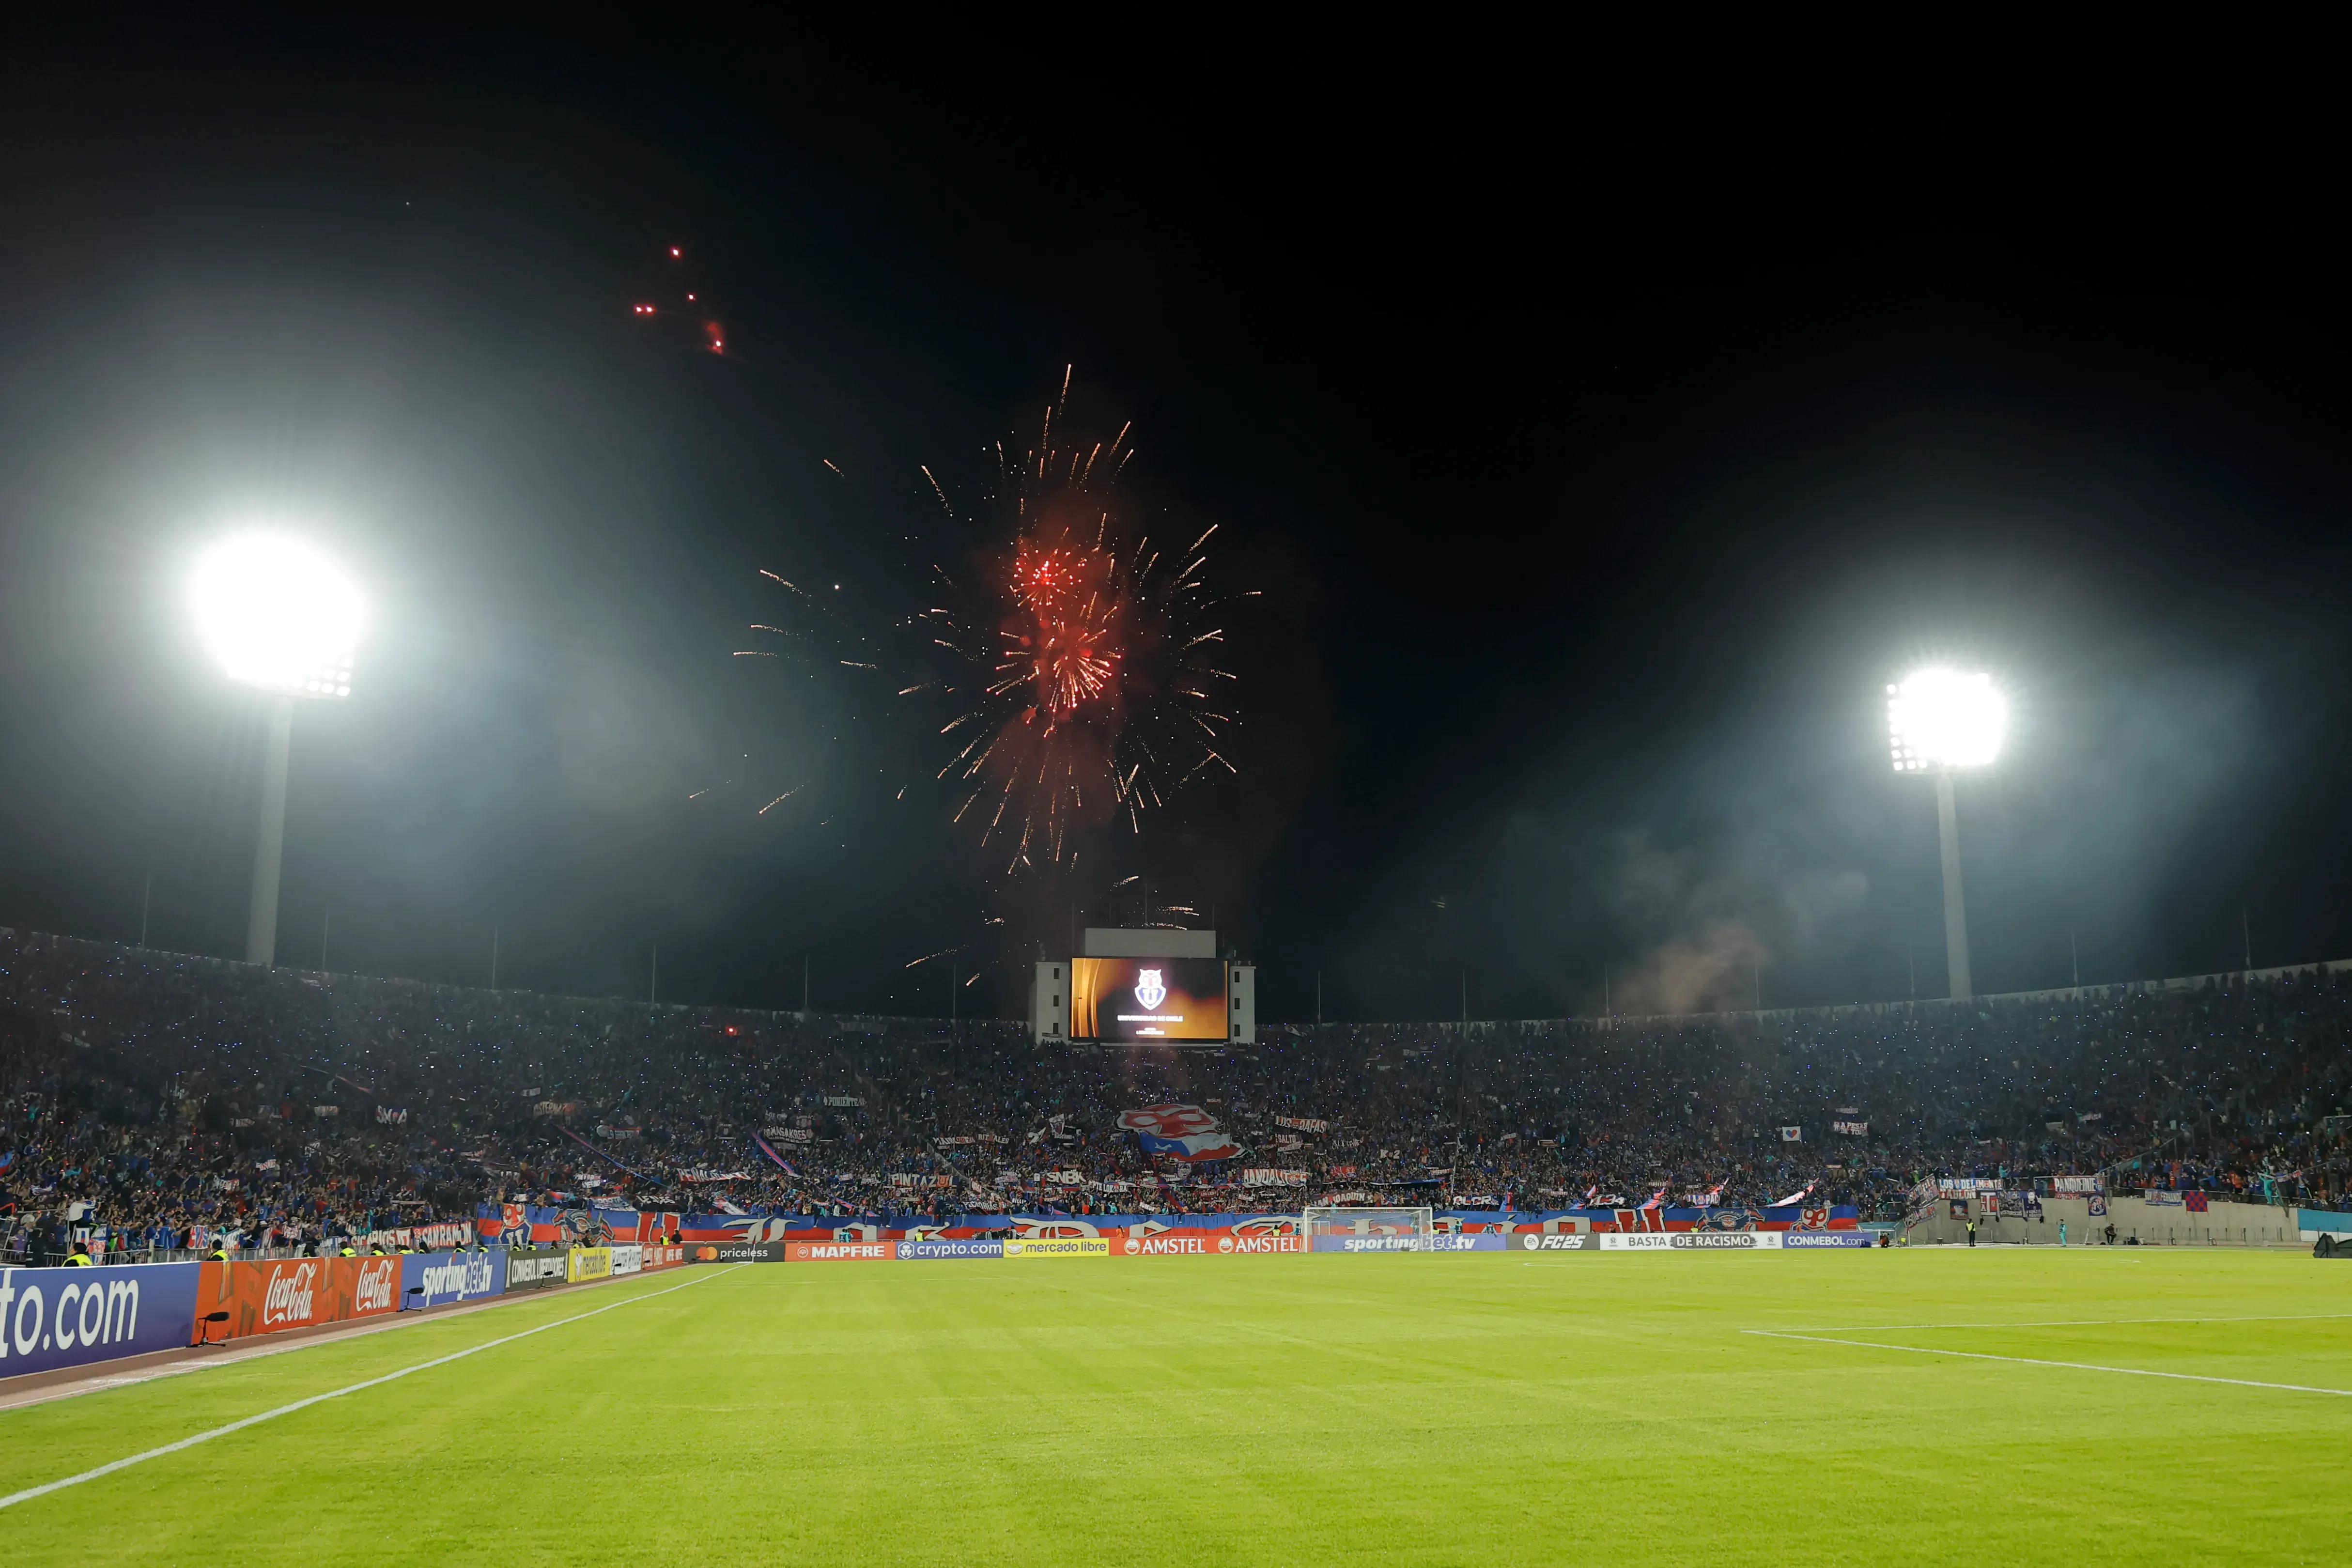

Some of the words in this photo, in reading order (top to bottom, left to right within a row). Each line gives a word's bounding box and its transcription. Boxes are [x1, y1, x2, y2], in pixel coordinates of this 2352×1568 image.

[1278, 1134, 1296, 1144] SALTO
[1939, 1179, 1953, 1189] LOS
[1961, 1179, 1976, 1189] DEL
[1025, 1242, 1079, 1253] mercado
[1081, 1241, 1107, 1252] libre
[1141, 1238, 1206, 1254] AMSTEL
[1235, 1237, 1298, 1253] AMSTEL
[1344, 1233, 1476, 1252] sportingbet.tv
[1540, 1235, 1587, 1249] FC25
[1628, 1237, 1667, 1246] BASTA
[1676, 1236, 1693, 1246] DE
[1696, 1235, 1751, 1246] RACISMO
[1787, 1236, 1865, 1246] CONMEBOL.com
[720, 1248, 768, 1259] priceless
[811, 1245, 885, 1258] MAPFRE
[917, 1243, 1002, 1258] crypto.com
[511, 1258, 536, 1283] CONMEBOL
[537, 1256, 565, 1279] LIBERTADORES
